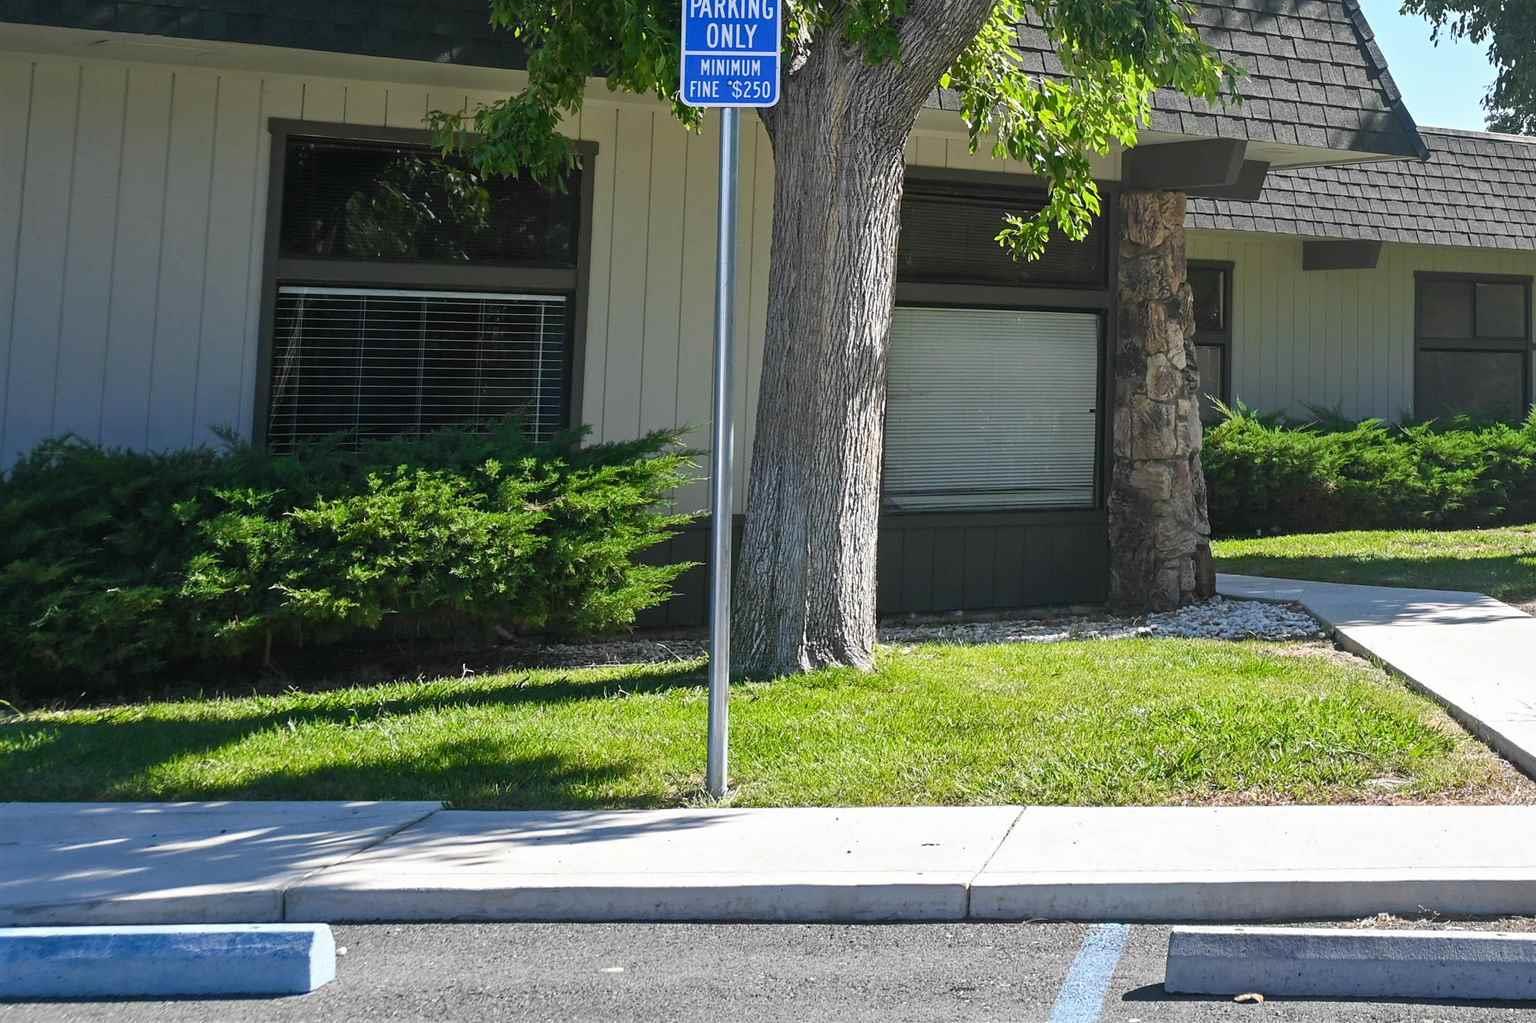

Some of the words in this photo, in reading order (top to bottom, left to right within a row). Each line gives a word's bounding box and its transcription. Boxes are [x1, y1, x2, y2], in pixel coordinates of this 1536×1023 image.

[706, 23, 758, 48] ONLY
[700, 59, 761, 77] MINIMUM
[689, 80, 720, 98] FINE
[731, 80, 771, 99] $250
